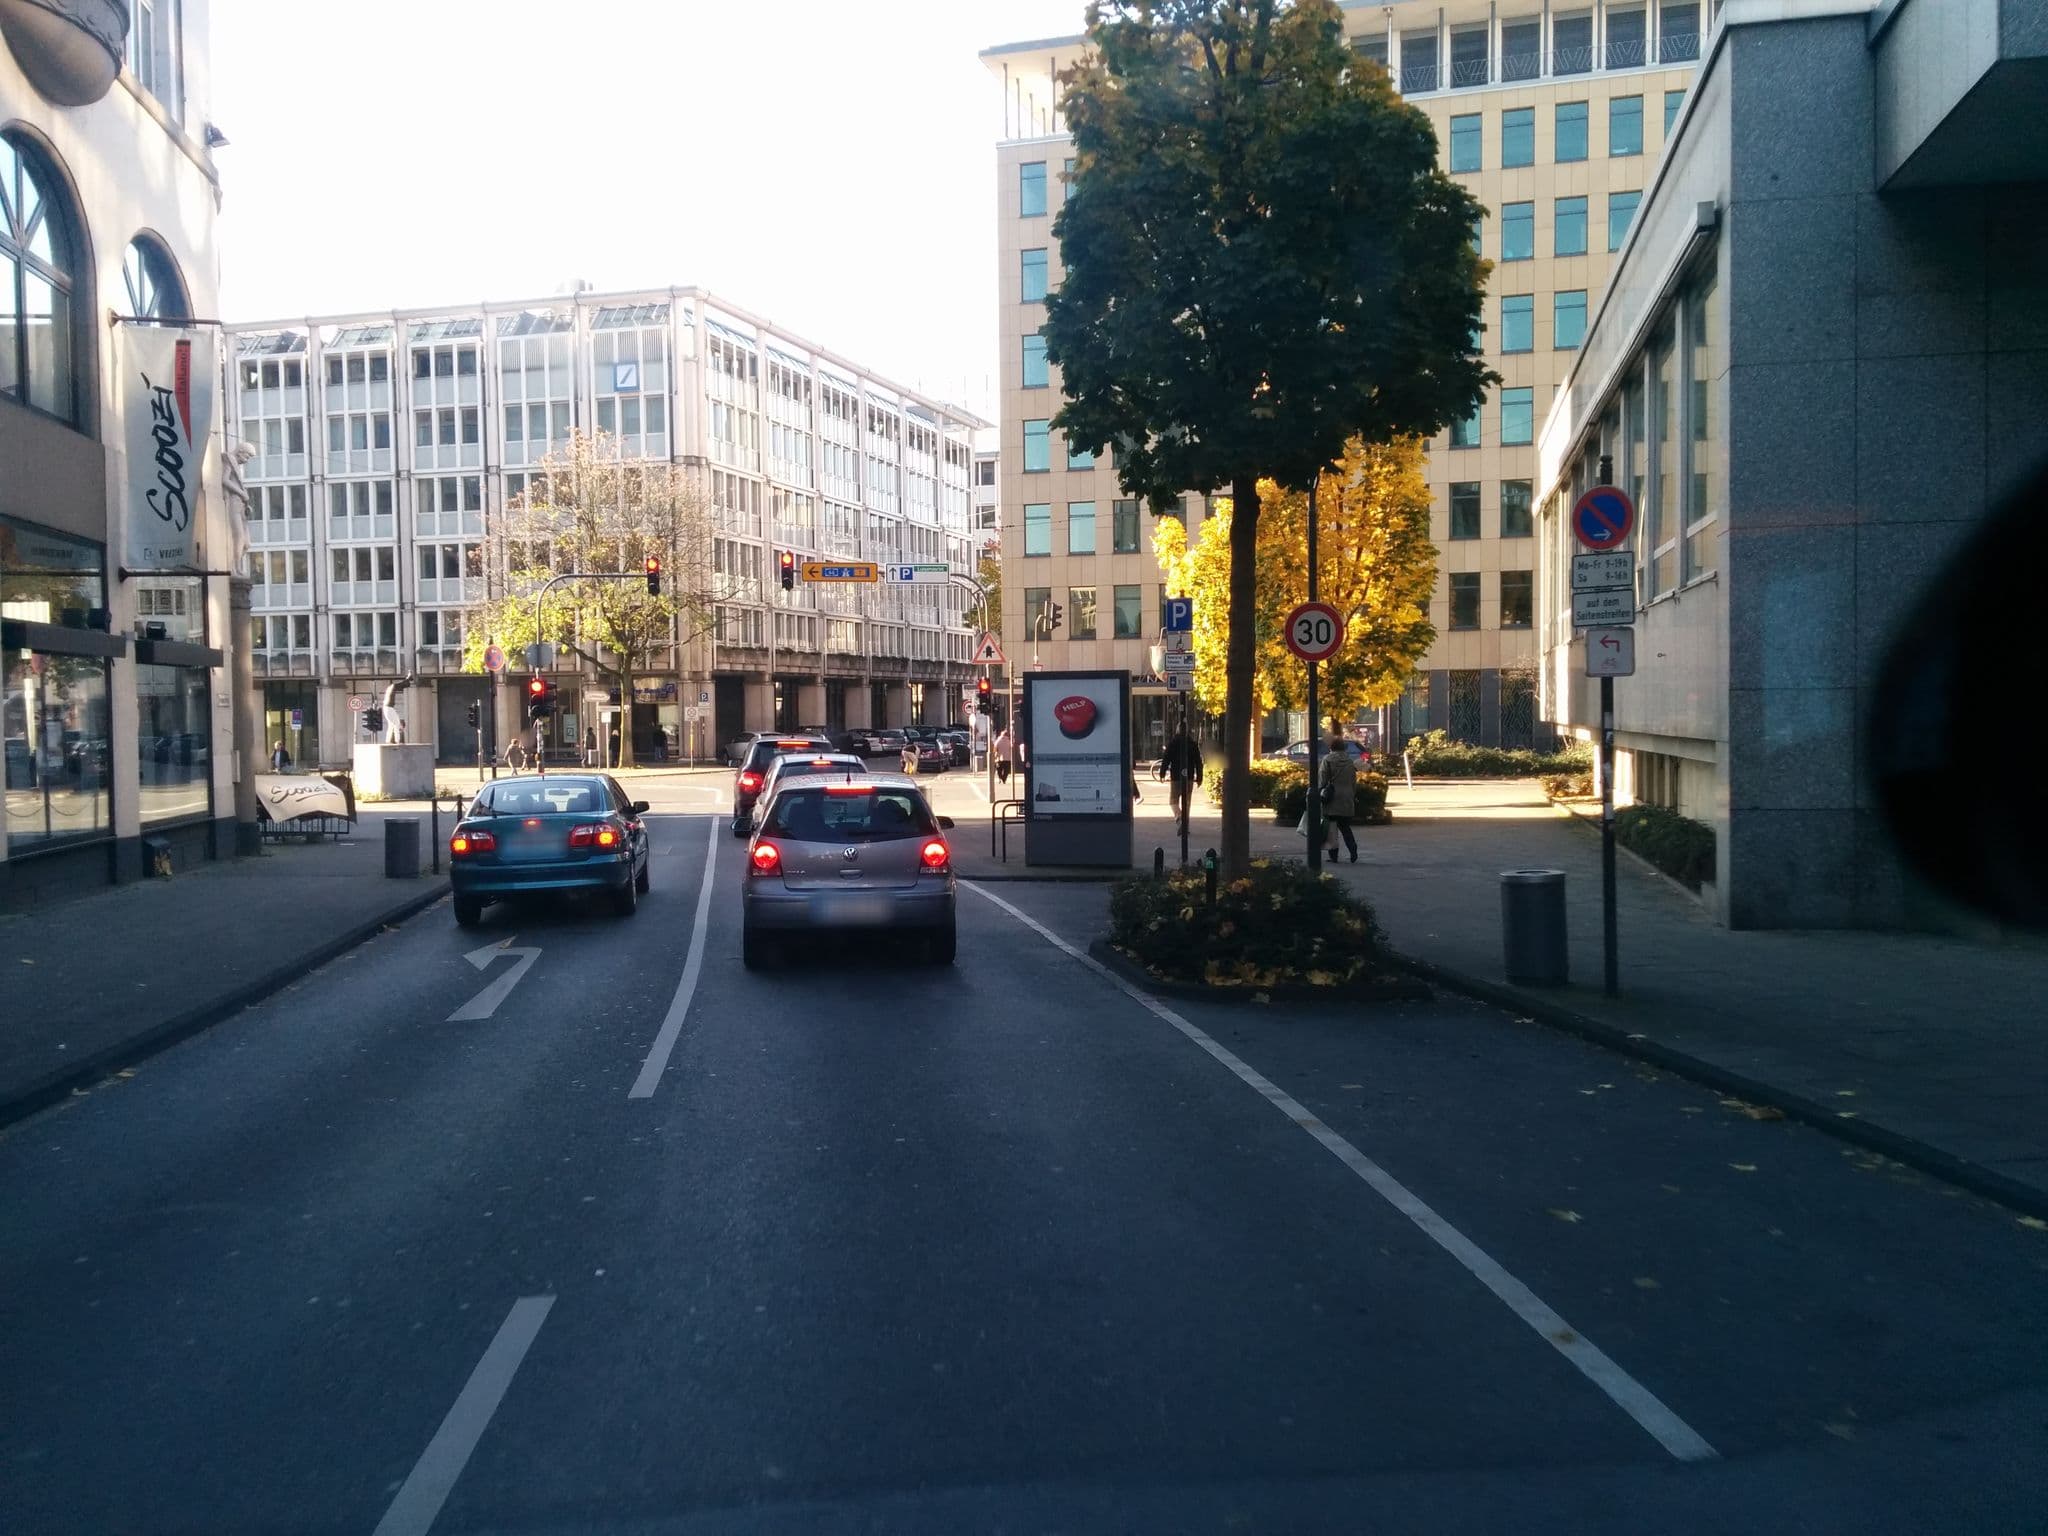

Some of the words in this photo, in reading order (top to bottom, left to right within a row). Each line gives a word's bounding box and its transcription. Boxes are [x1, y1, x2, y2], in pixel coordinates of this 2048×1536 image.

[902, 568, 911, 579] P
[1586, 598, 1600, 608] auf
[1603, 597, 1620, 607] dem
[1172, 602, 1187, 628] P
[1298, 619, 1331, 646] 30
[1062, 700, 1087, 713] HELP
